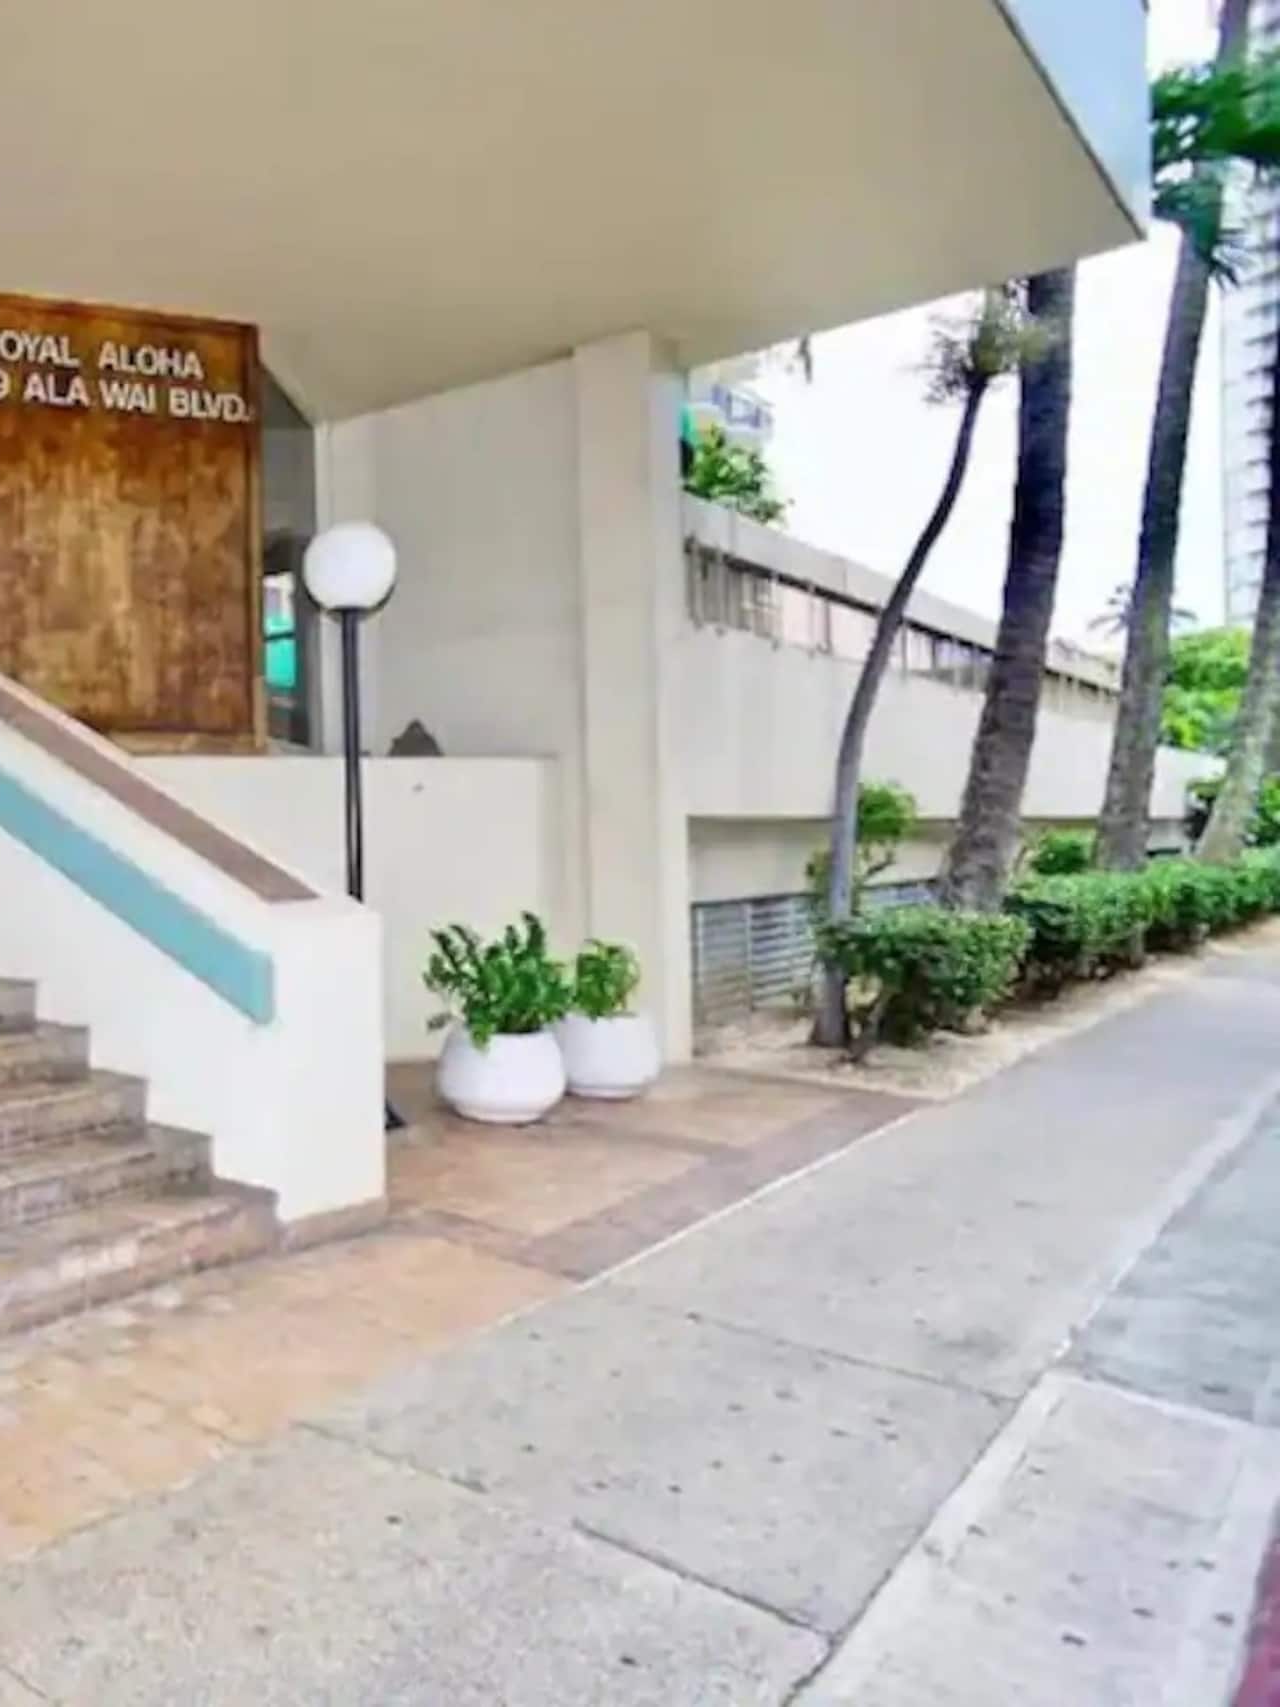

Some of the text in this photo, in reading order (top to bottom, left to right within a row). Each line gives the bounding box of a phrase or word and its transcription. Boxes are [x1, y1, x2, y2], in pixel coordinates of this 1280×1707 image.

[98, 339, 204, 380] ALOHA
[23, 372, 90, 407] ALA
[99, 379, 156, 414] WAI
[170, 387, 255, 424] BLVD.
